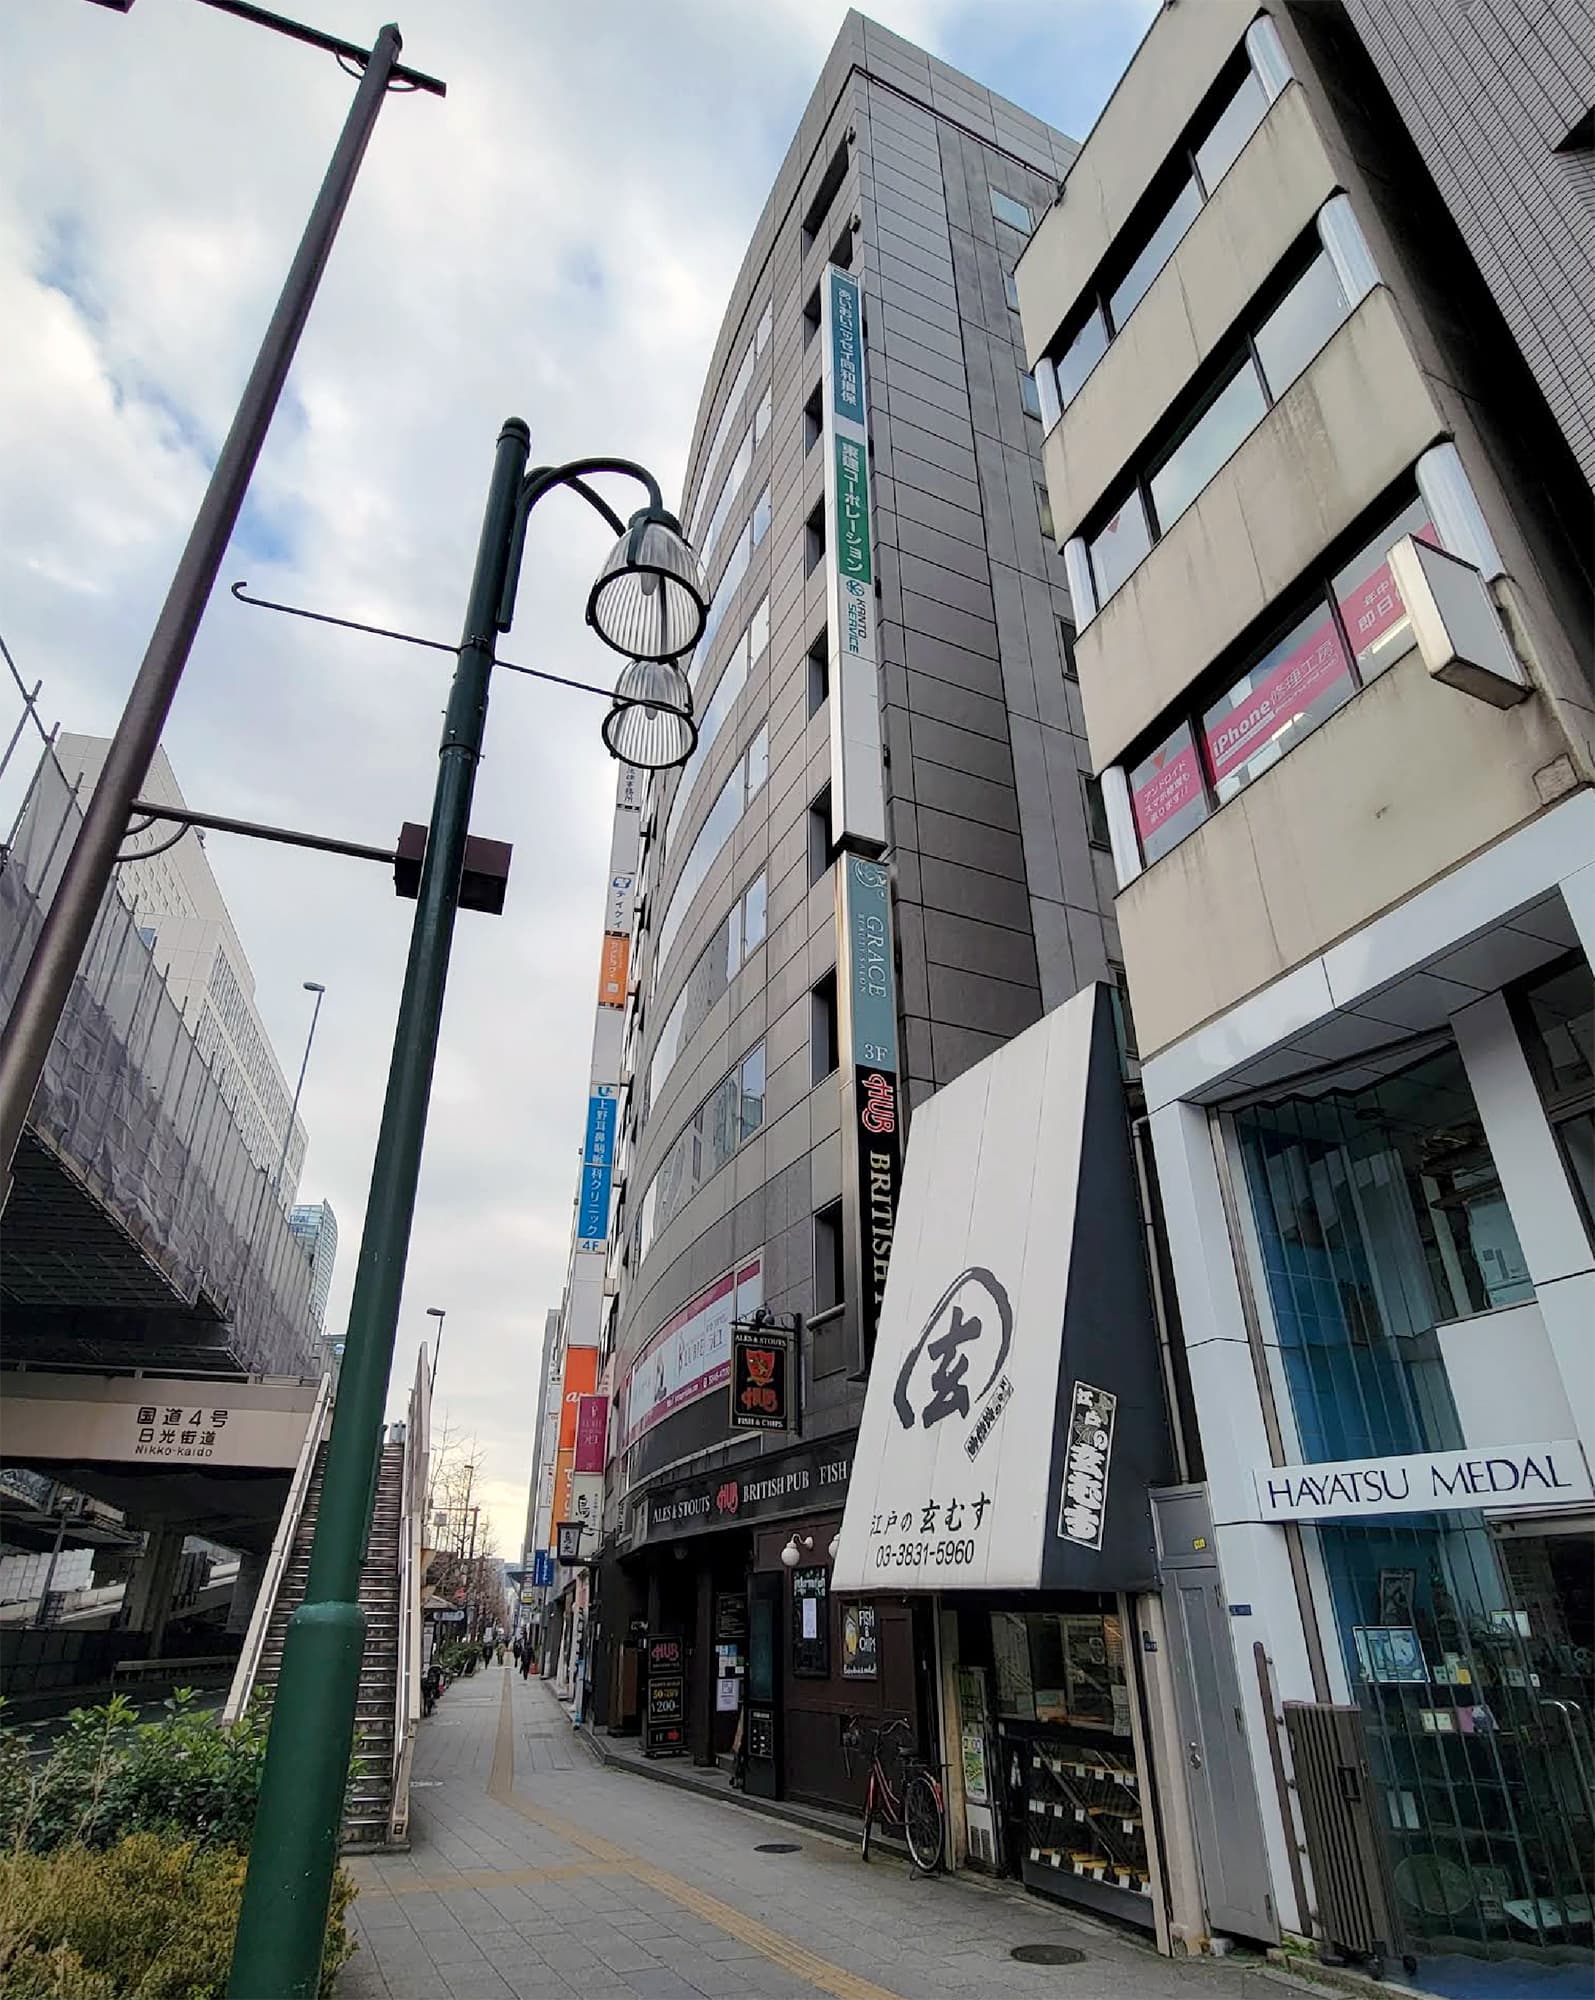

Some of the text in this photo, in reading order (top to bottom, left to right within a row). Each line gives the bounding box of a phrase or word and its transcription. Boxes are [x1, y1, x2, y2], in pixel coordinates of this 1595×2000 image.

[838, 287, 857, 406] あいおいニッセイ同和損保
[848, 604, 858, 653] SERVICE
[857, 599, 867, 639] KANTO
[866, 915, 887, 998] GRACE
[864, 1043, 888, 1062] 3F
[862, 1073, 895, 1133] HUB
[870, 1150, 893, 1283] BRITISH
[582, 1239, 600, 1252] 4F
[136, 1406, 229, 1428] 国道4号
[138, 1427, 217, 1446] 日光街道
[737, 1416, 754, 1426] FISH
[762, 1419, 784, 1429] CHIPS
[652, 1503, 671, 1524] ALES
[678, 1495, 710, 1518] STOUTS
[743, 1478, 785, 1503] BRITISH
[786, 1470, 809, 1491] PUB
[819, 1460, 847, 1486] FISH
[1267, 1455, 1573, 1509] HAYATSU MEDAL
[876, 1538, 975, 1569] 03-3831-5960
